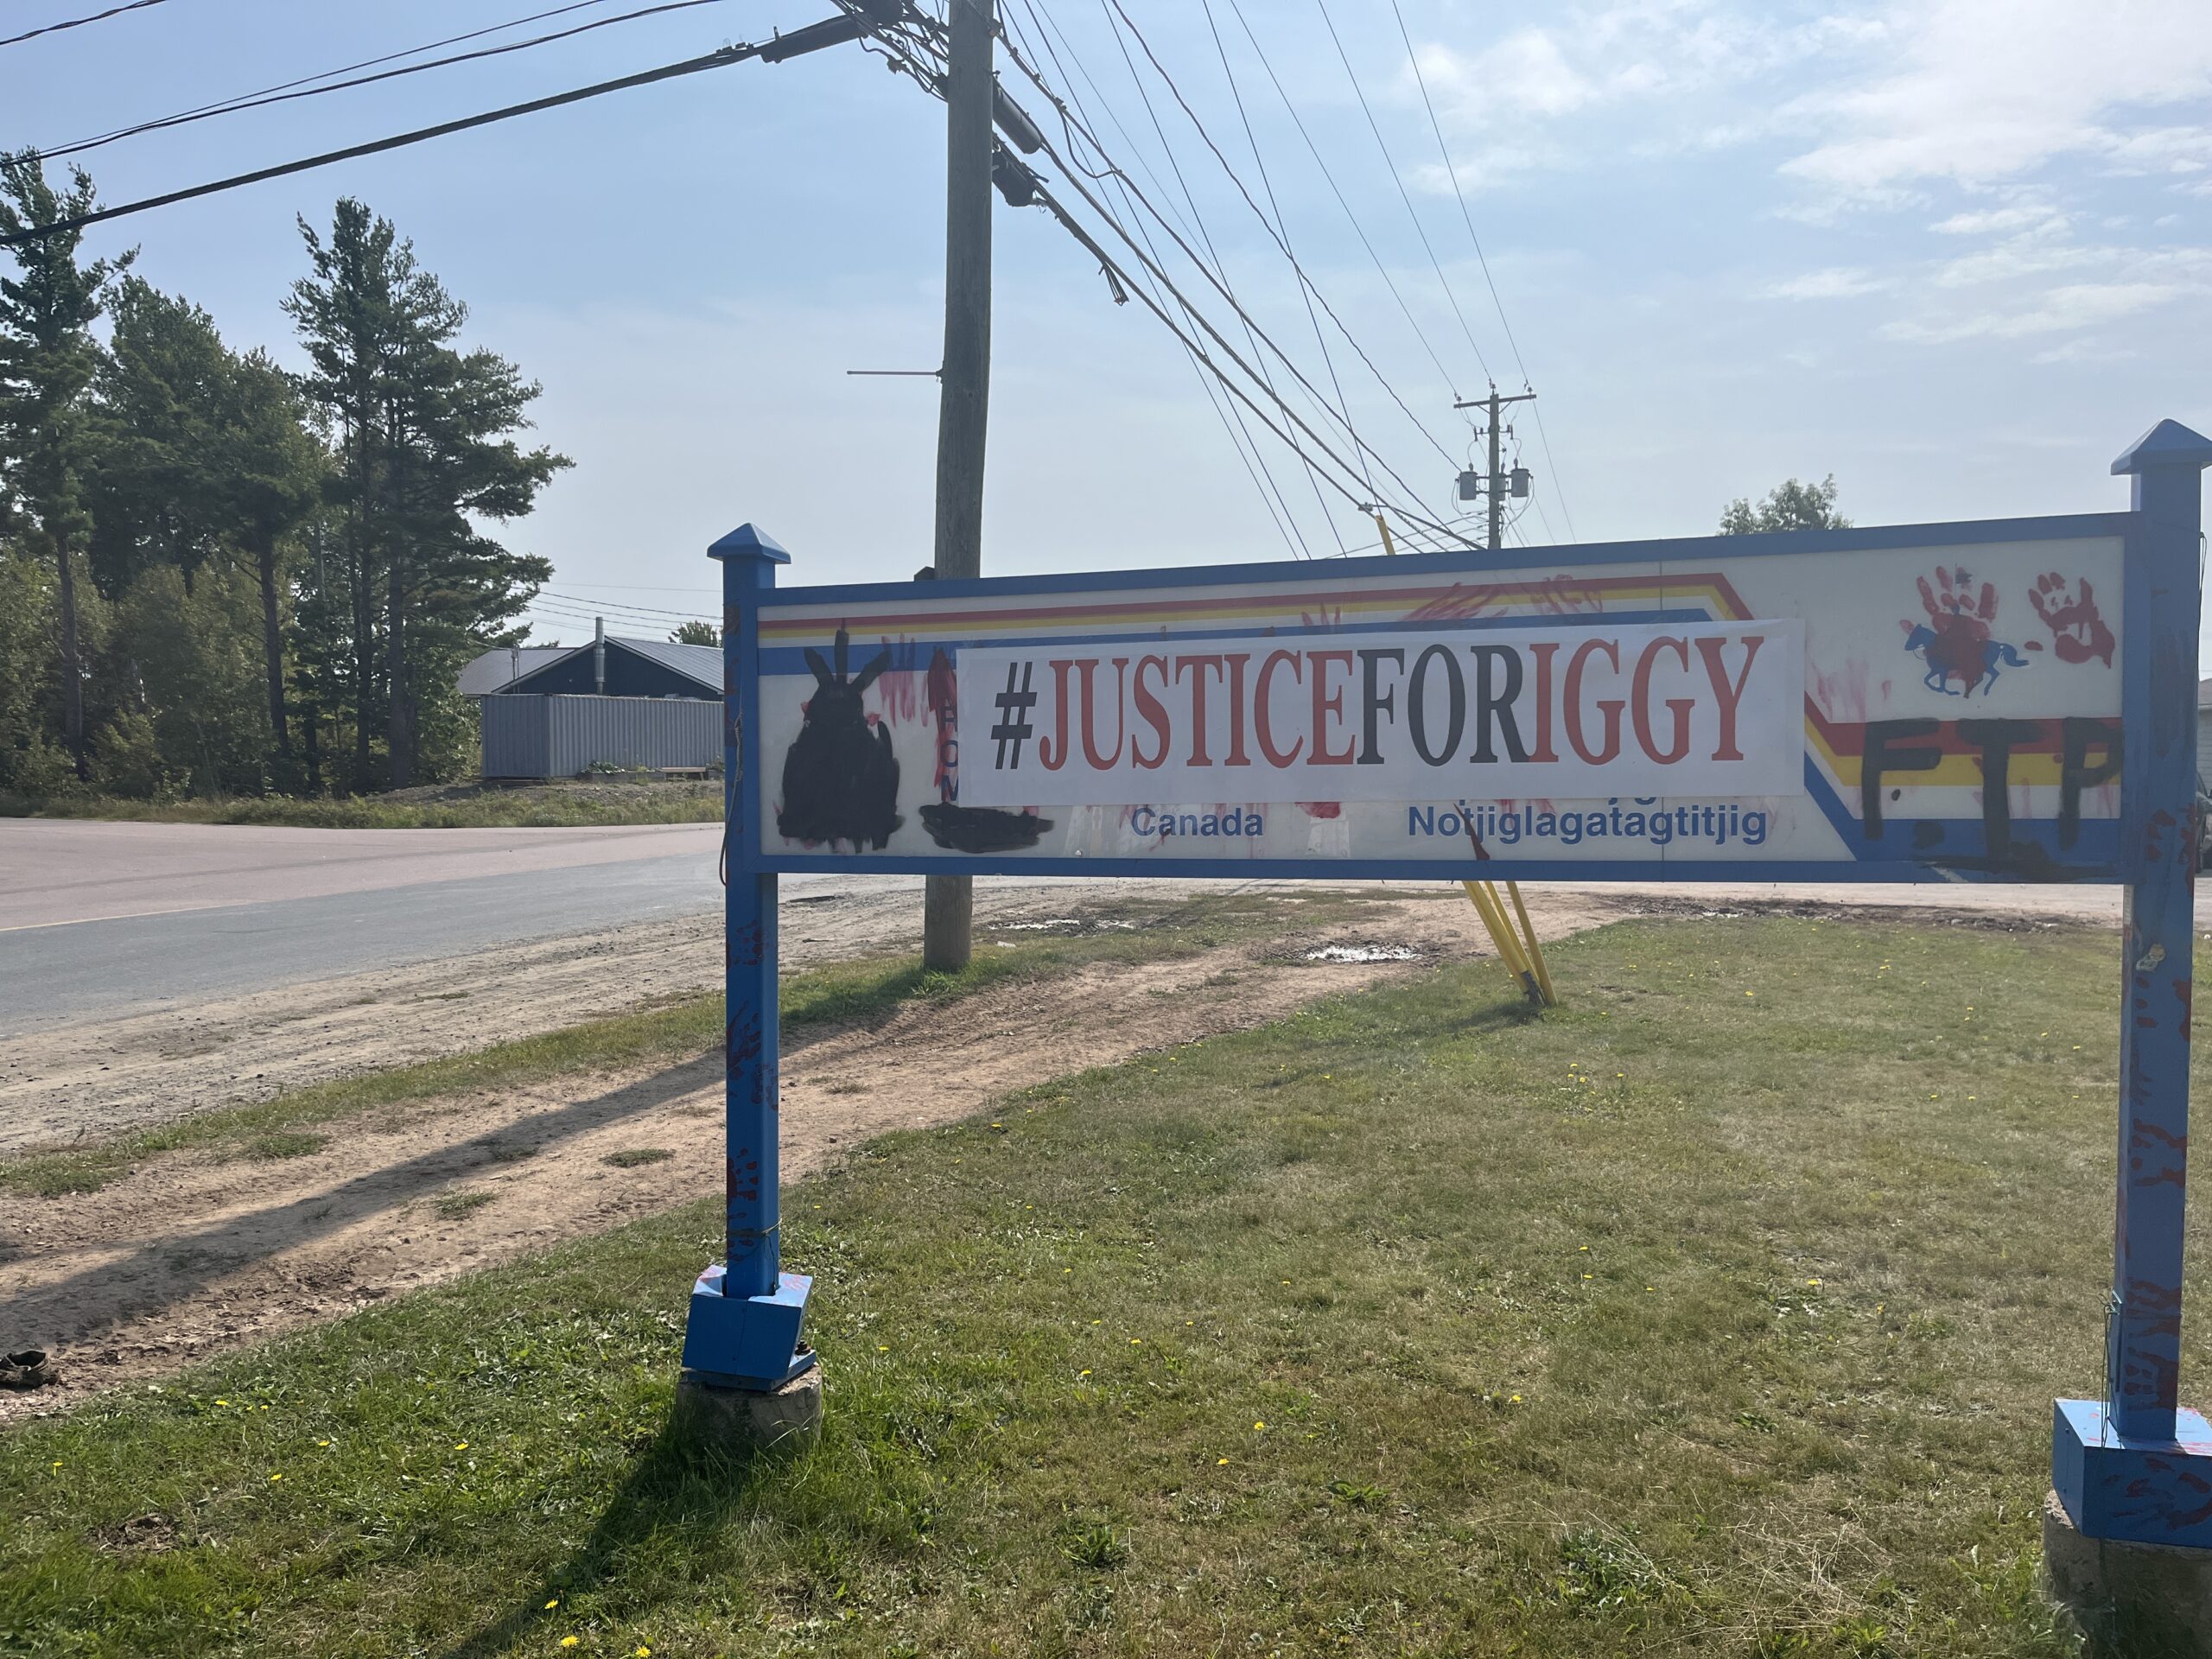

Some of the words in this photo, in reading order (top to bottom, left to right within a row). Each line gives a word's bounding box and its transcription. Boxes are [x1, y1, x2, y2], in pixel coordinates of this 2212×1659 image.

[991, 636, 1764, 770] #JUSTICEFORIGGY
[1132, 807, 1263, 836] Canada
[1861, 716, 2125, 861] FTP
